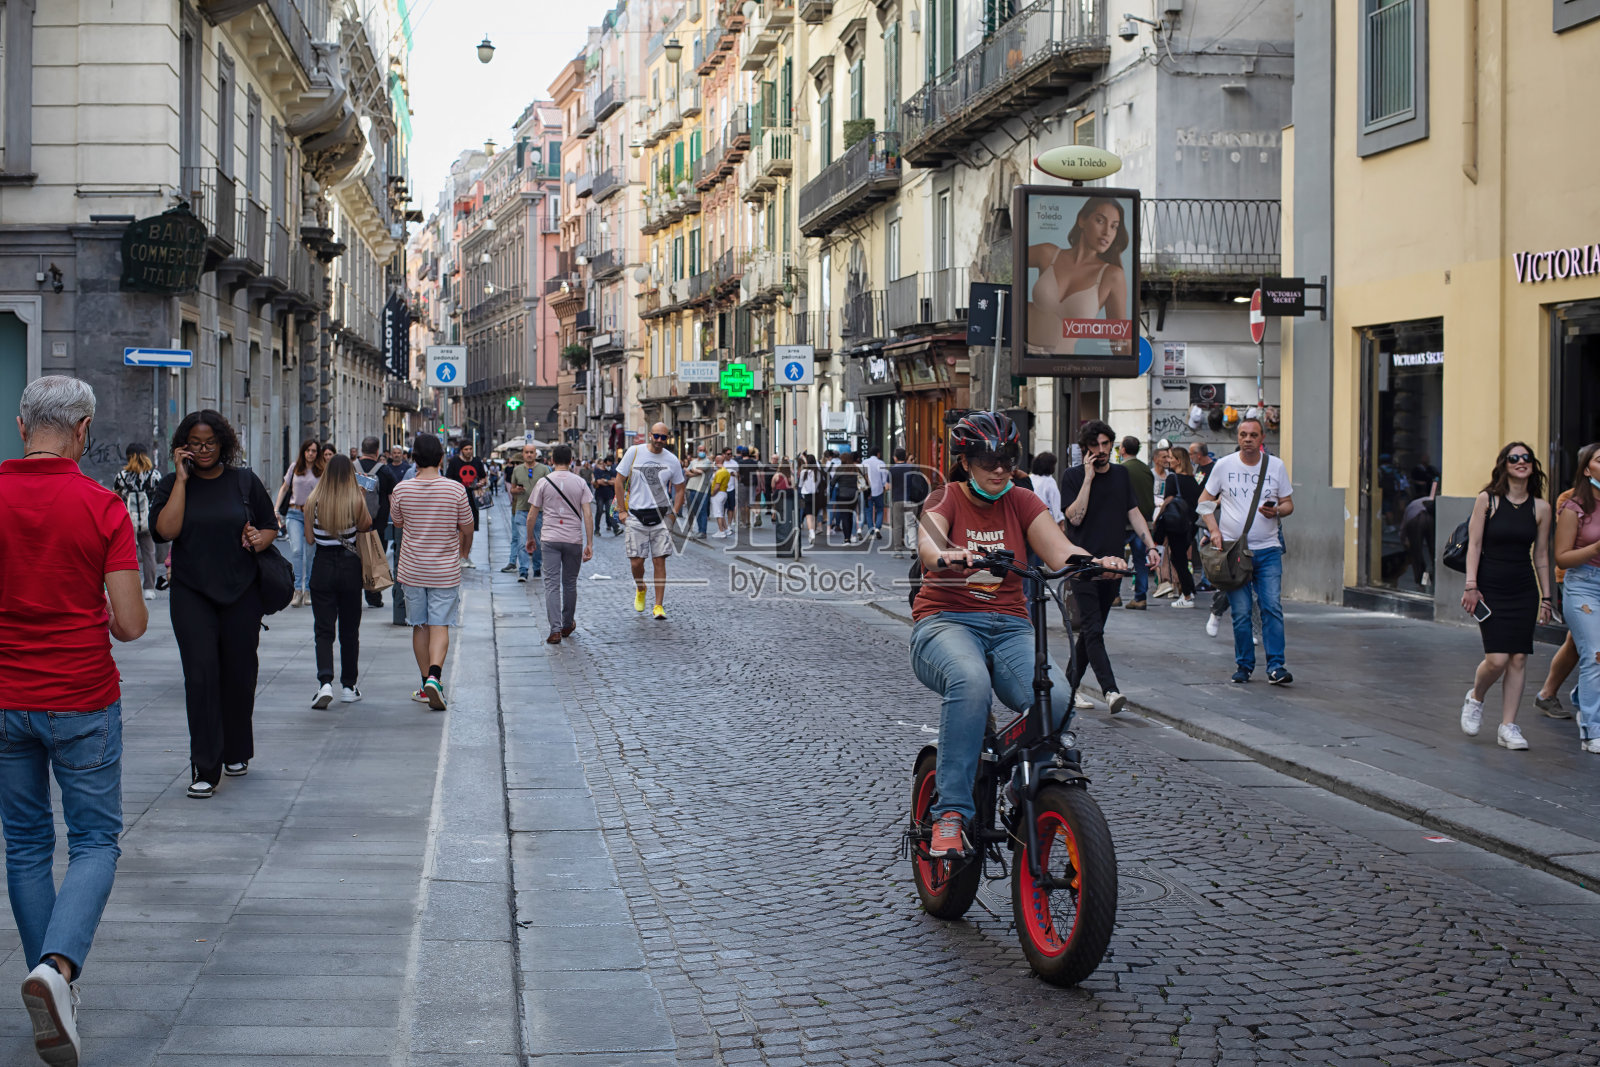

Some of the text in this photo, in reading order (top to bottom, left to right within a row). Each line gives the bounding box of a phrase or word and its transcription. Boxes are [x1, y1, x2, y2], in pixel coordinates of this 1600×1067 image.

[1061, 157, 1107, 168] via Toledo
[1036, 211, 1063, 221] Toledo
[148, 222, 200, 244] BANCA
[1512, 243, 1600, 283] VICTORIA
[385, 308, 393, 369] ALCOTT
[781, 353, 807, 361] pedonale
[966, 528, 1005, 542] PEANUT
